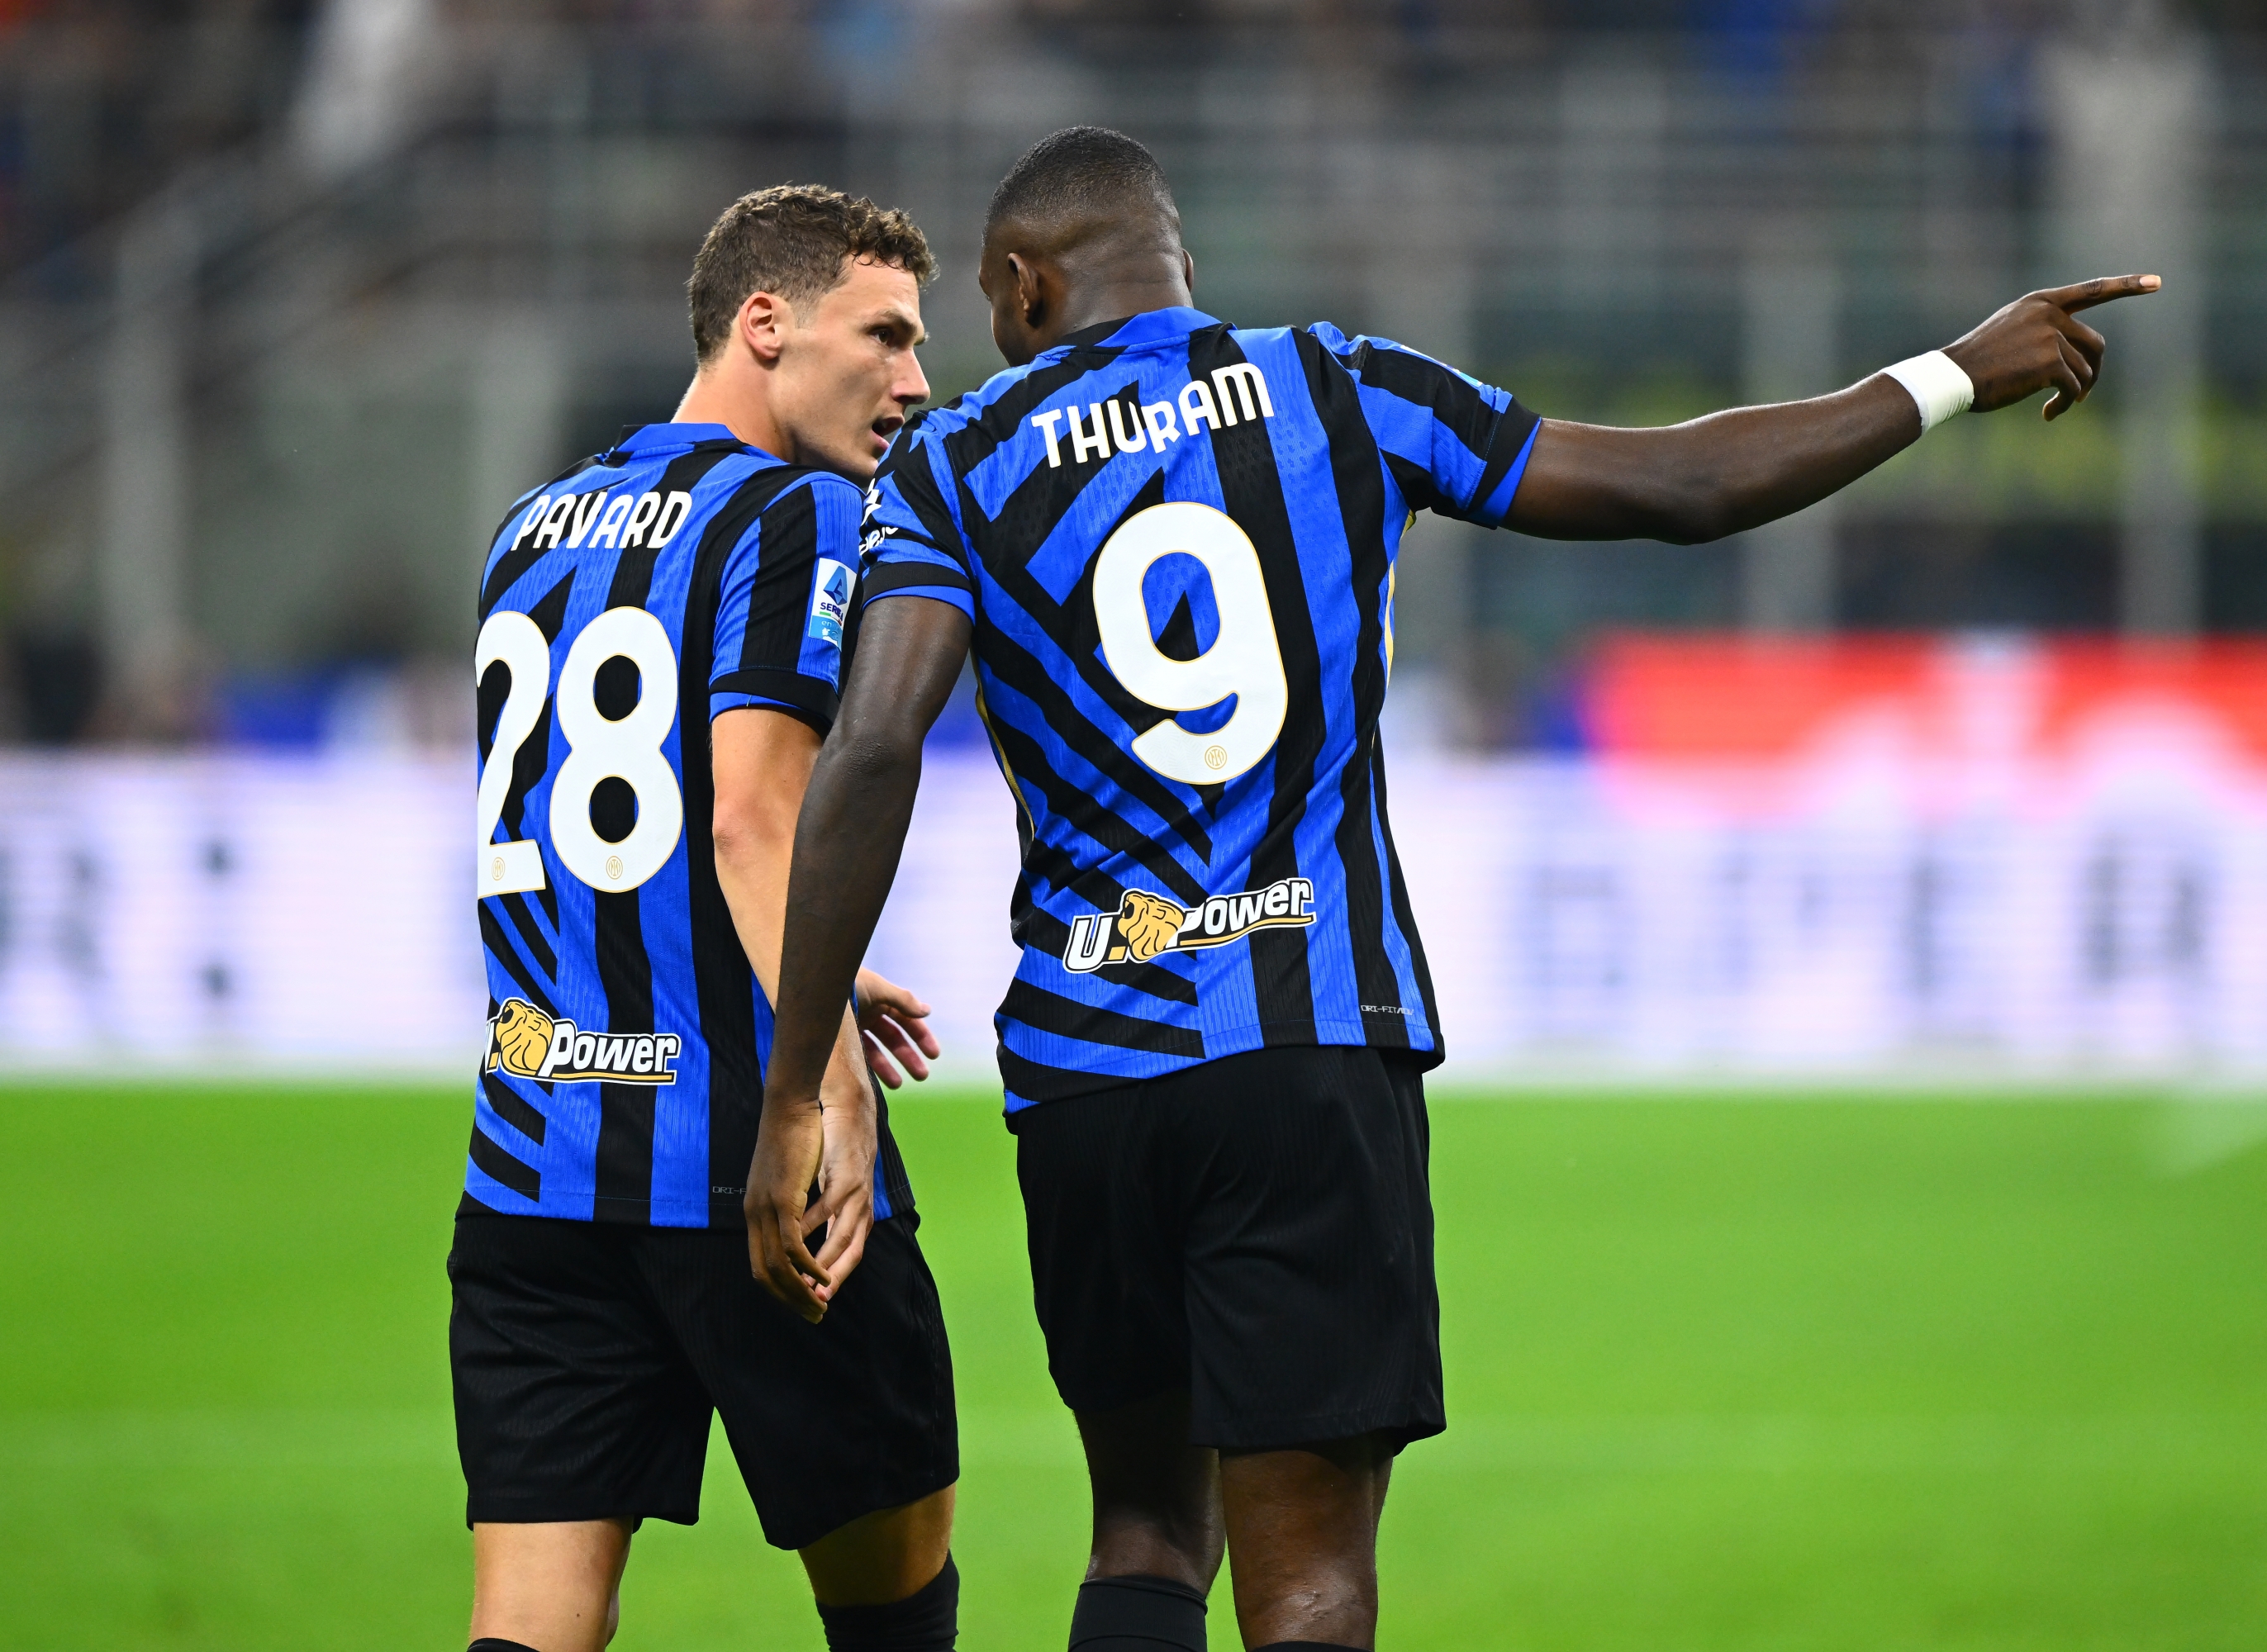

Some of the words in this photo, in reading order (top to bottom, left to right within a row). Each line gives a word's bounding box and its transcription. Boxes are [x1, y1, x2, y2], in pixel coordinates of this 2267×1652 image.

[1030, 362, 1275, 468] THURAM
[510, 490, 692, 552] PAVARD
[1092, 501, 1289, 786] 9
[474, 605, 683, 899] 28
[537, 1020, 679, 1078] Power
[712, 1185, 747, 1194] DRI-F
